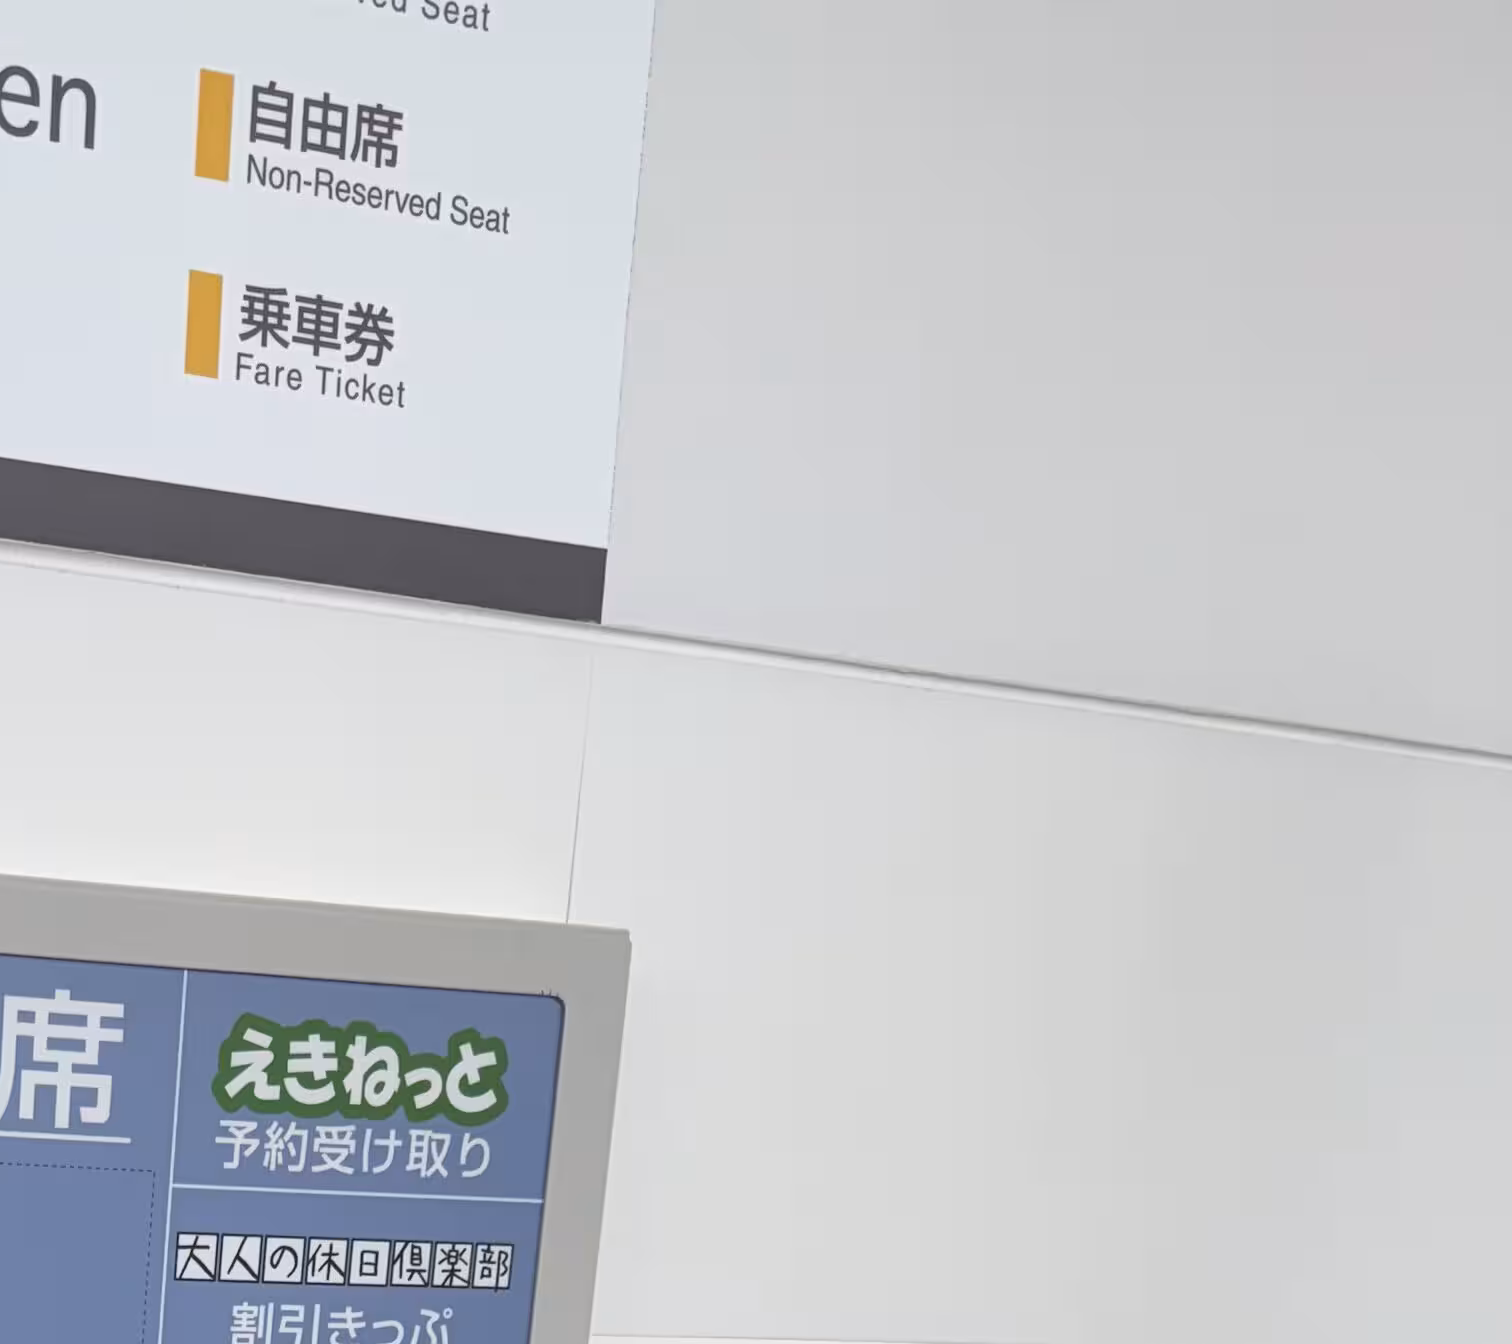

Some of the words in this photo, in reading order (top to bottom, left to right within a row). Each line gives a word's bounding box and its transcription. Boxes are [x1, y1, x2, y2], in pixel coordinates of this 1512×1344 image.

[250, 81, 403, 168] 自由席
[247, 153, 441, 220] Non-Reserved
[450, 195, 509, 233] Seat
[238, 284, 394, 366] 乗車券
[235, 352, 303, 390] Fare
[316, 365, 405, 408] Ticket
[223, 1027, 498, 1114] えきねっと
[215, 1119, 491, 1179] 予約受け取り
[177, 1234, 511, 1291] 大人の休日倶楽部
